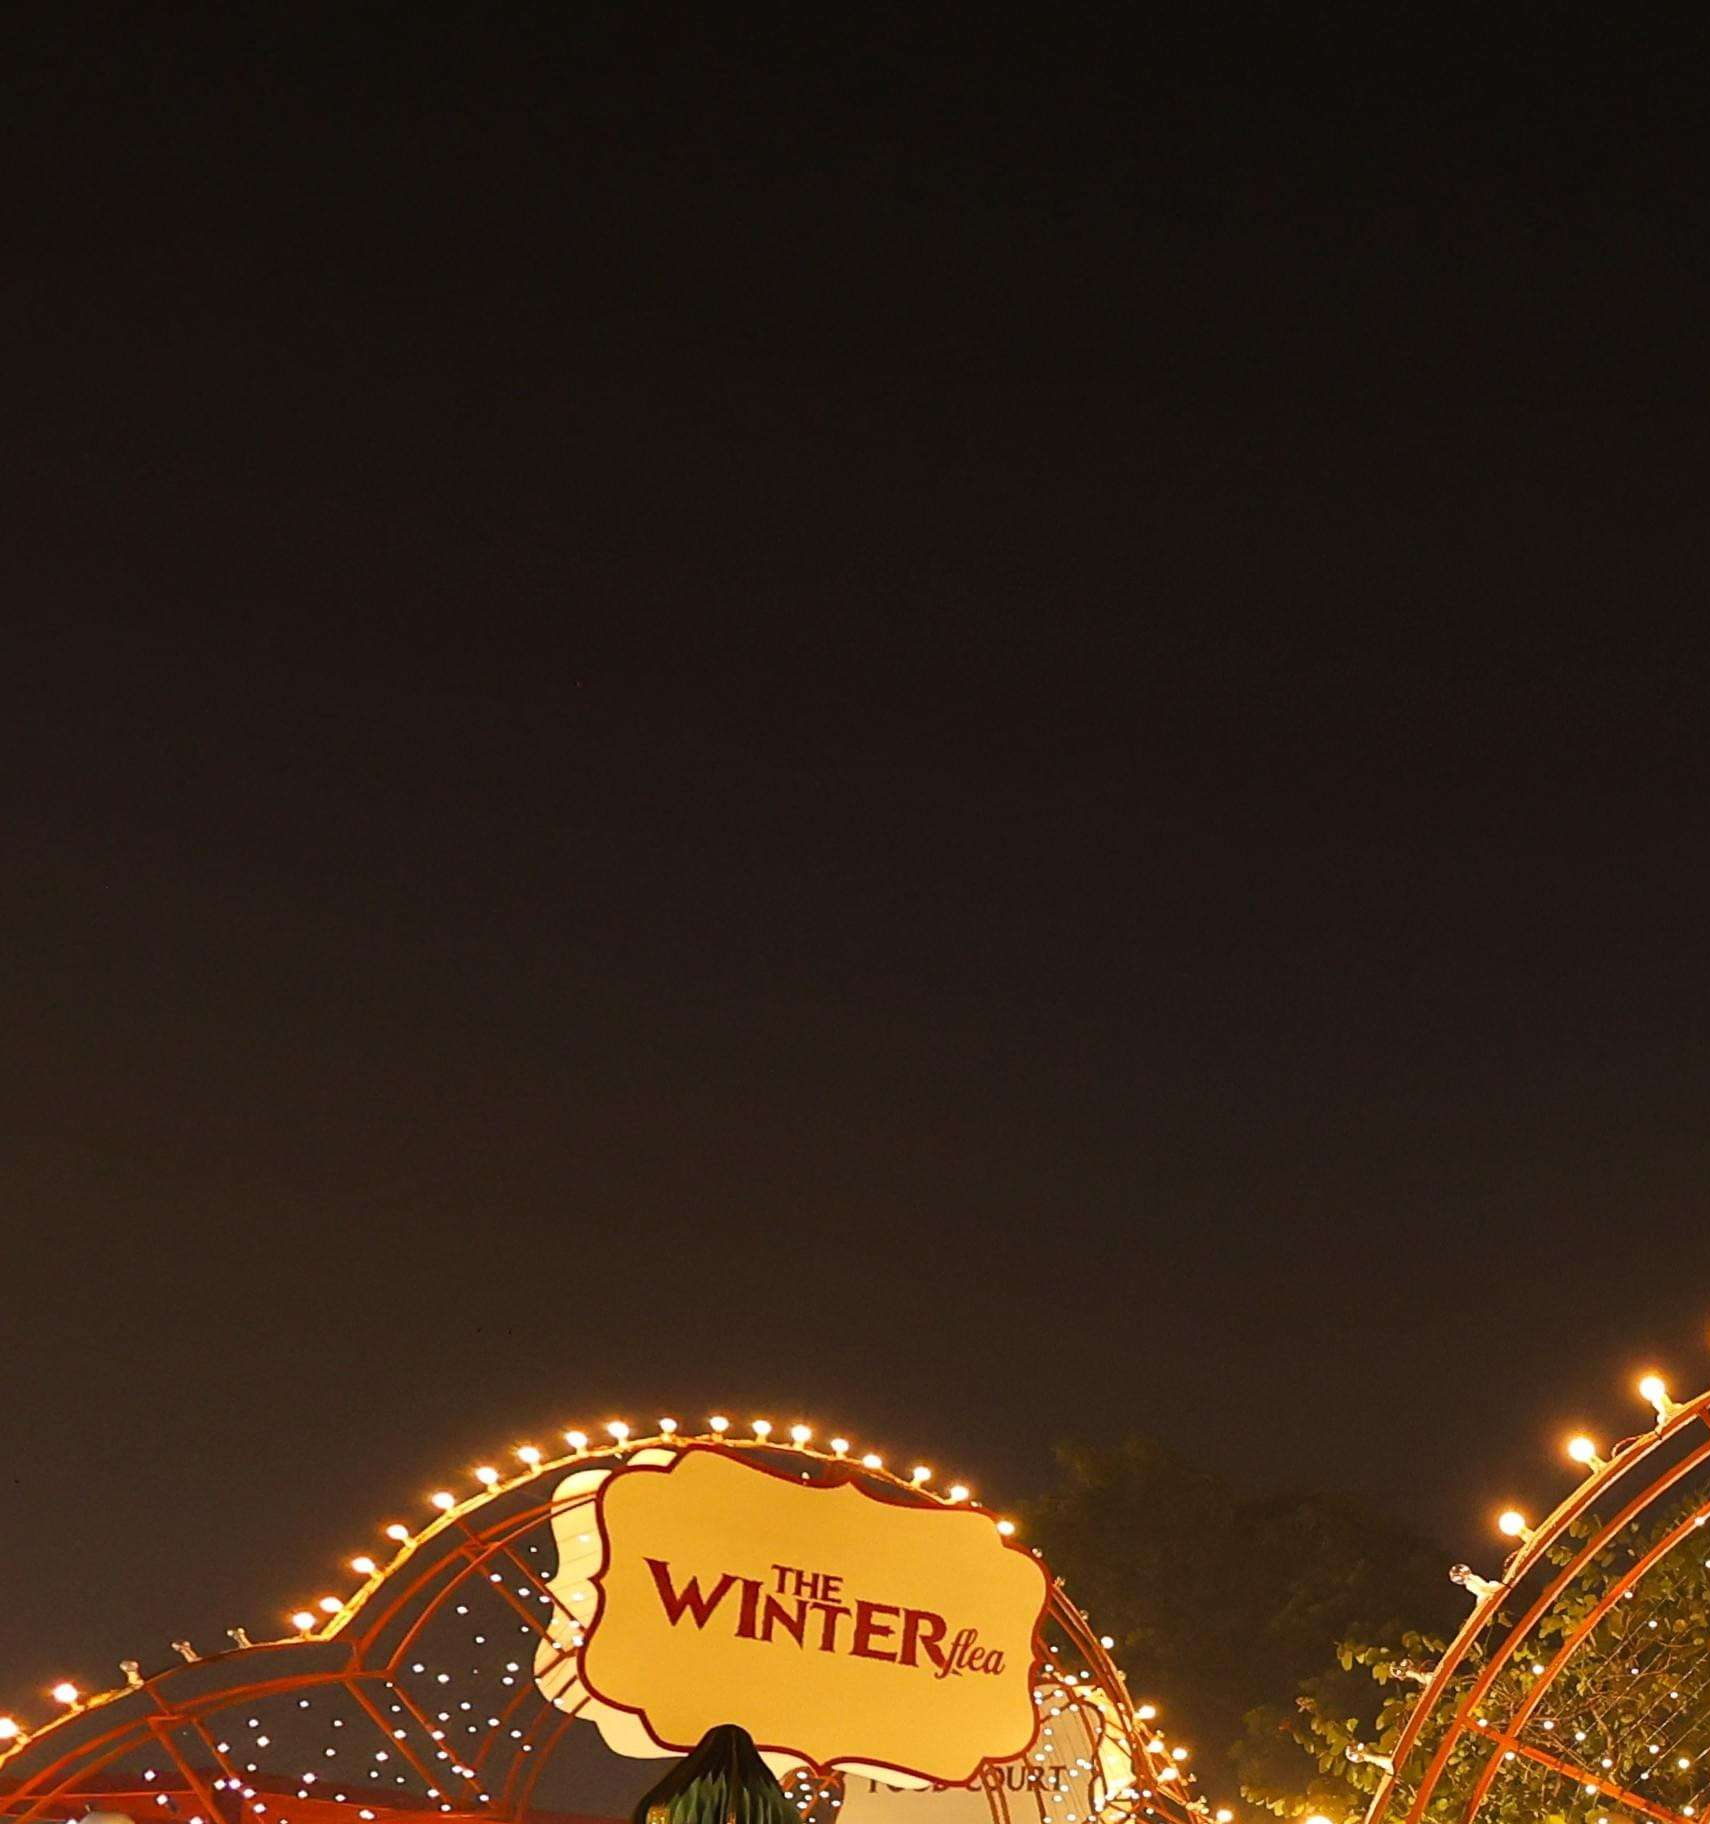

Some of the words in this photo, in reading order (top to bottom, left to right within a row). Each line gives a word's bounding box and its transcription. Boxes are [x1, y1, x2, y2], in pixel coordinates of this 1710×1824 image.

[771, 1564, 843, 1604] THE
[643, 1557, 962, 1676] WINTER
[934, 1628, 1006, 1679] flea
[967, 1766, 1067, 1791] OURT
